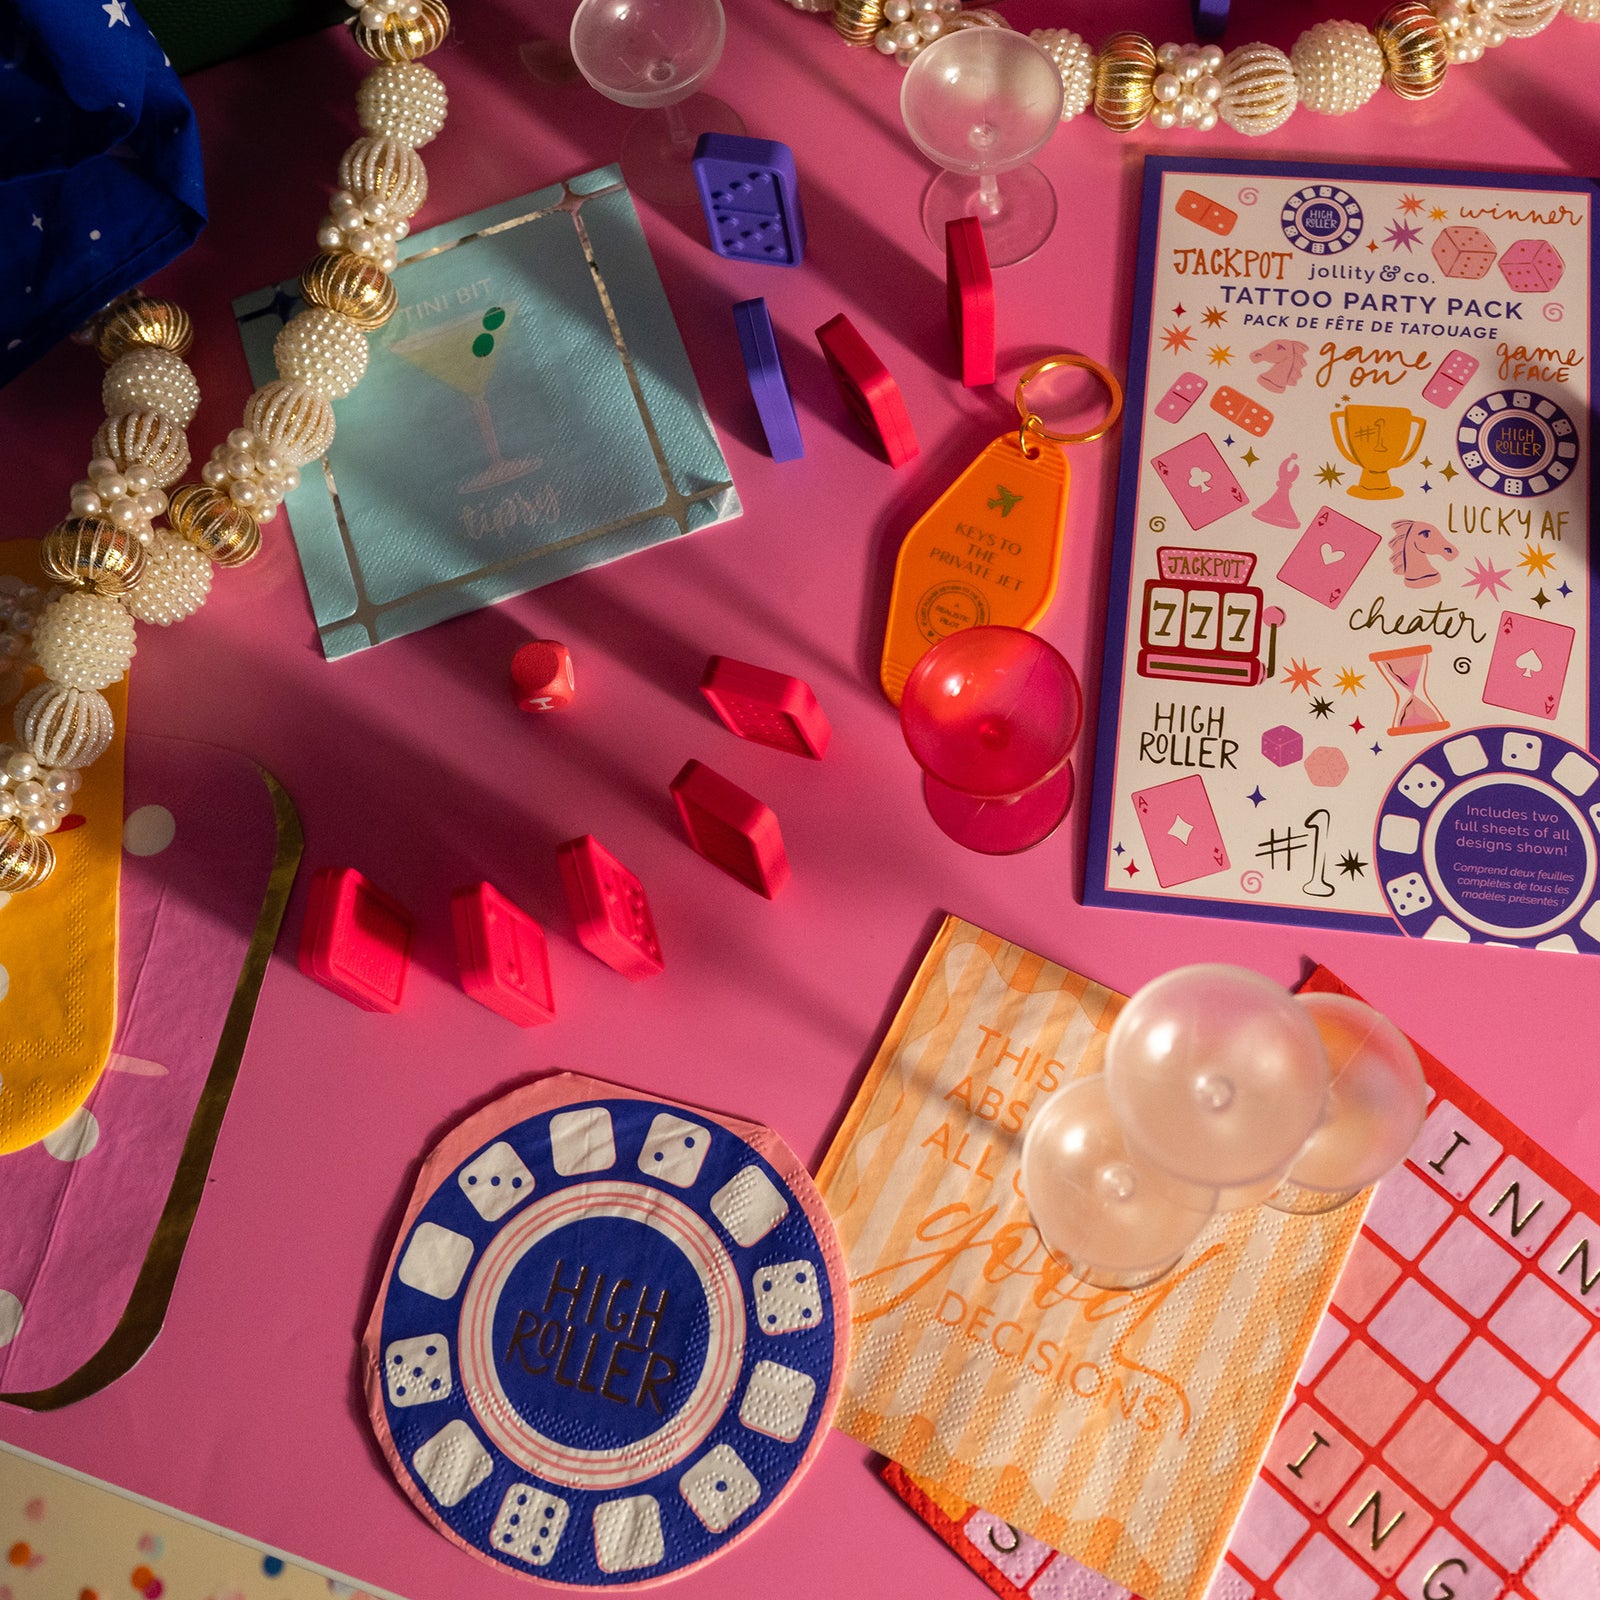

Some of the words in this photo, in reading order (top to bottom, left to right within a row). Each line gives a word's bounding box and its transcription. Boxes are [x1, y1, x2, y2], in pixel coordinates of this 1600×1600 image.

[1309, 209, 1333, 219] HIGH
[1459, 203, 1583, 227] winner
[1173, 248, 1293, 280] JACKPOT
[456, 277, 491, 305] BIT
[1220, 285, 1333, 309] TATTOO
[1343, 291, 1438, 315] PARTY
[1447, 298, 1524, 320] PACK
[1243, 313, 1289, 328] PACK
[1296, 315, 1318, 329] DE
[1325, 315, 1365, 333] FÊTE
[1370, 320, 1394, 334] DE
[1400, 321, 1498, 340] TATOUAGE
[1316, 341, 1432, 388] game
[1349, 366, 1408, 388] on
[1496, 342, 1584, 381] game
[1513, 363, 1570, 383] FACE
[1495, 439, 1542, 457] ROLLER
[1501, 427, 1535, 443] HIGH
[1448, 503, 1531, 539] LUCKY
[1540, 510, 1570, 541] AF
[955, 522, 997, 547] KEYS
[1000, 538, 1022, 556] TO
[968, 543, 996, 564] THE
[929, 547, 990, 580] PRIVATE
[995, 574, 1023, 592] JET
[1167, 556, 1245, 579] JACKPOT
[1349, 596, 1487, 644] cheater
[1154, 702, 1226, 738] HIGH
[1139, 732, 1240, 770] ROLLER
[1455, 819, 1478, 833] full
[1482, 822, 1530, 837] sheets
[1534, 827, 1549, 838] of
[1552, 829, 1570, 841] all
[1466, 804, 1528, 821] Includes
[1532, 810, 1559, 823] two
[1255, 809, 1336, 897] #1
[1456, 836, 1512, 853] designs
[1516, 842, 1568, 857] shown!
[1453, 862, 1508, 876] Comprend
[1510, 867, 1536, 879] deux
[1537, 869, 1575, 882] feuilles
[1513, 880, 1527, 891] de
[1530, 882, 1552, 893] tous
[1555, 884, 1570, 895] les
[976, 1024, 1065, 1093] THIS
[943, 1075, 1030, 1135] ABS
[921, 1122, 994, 1182] ALL
[543, 1258, 669, 1349] HIGH
[506, 1309, 677, 1415] ROLLER
[934, 1289, 1166, 1432] DECISIONS
